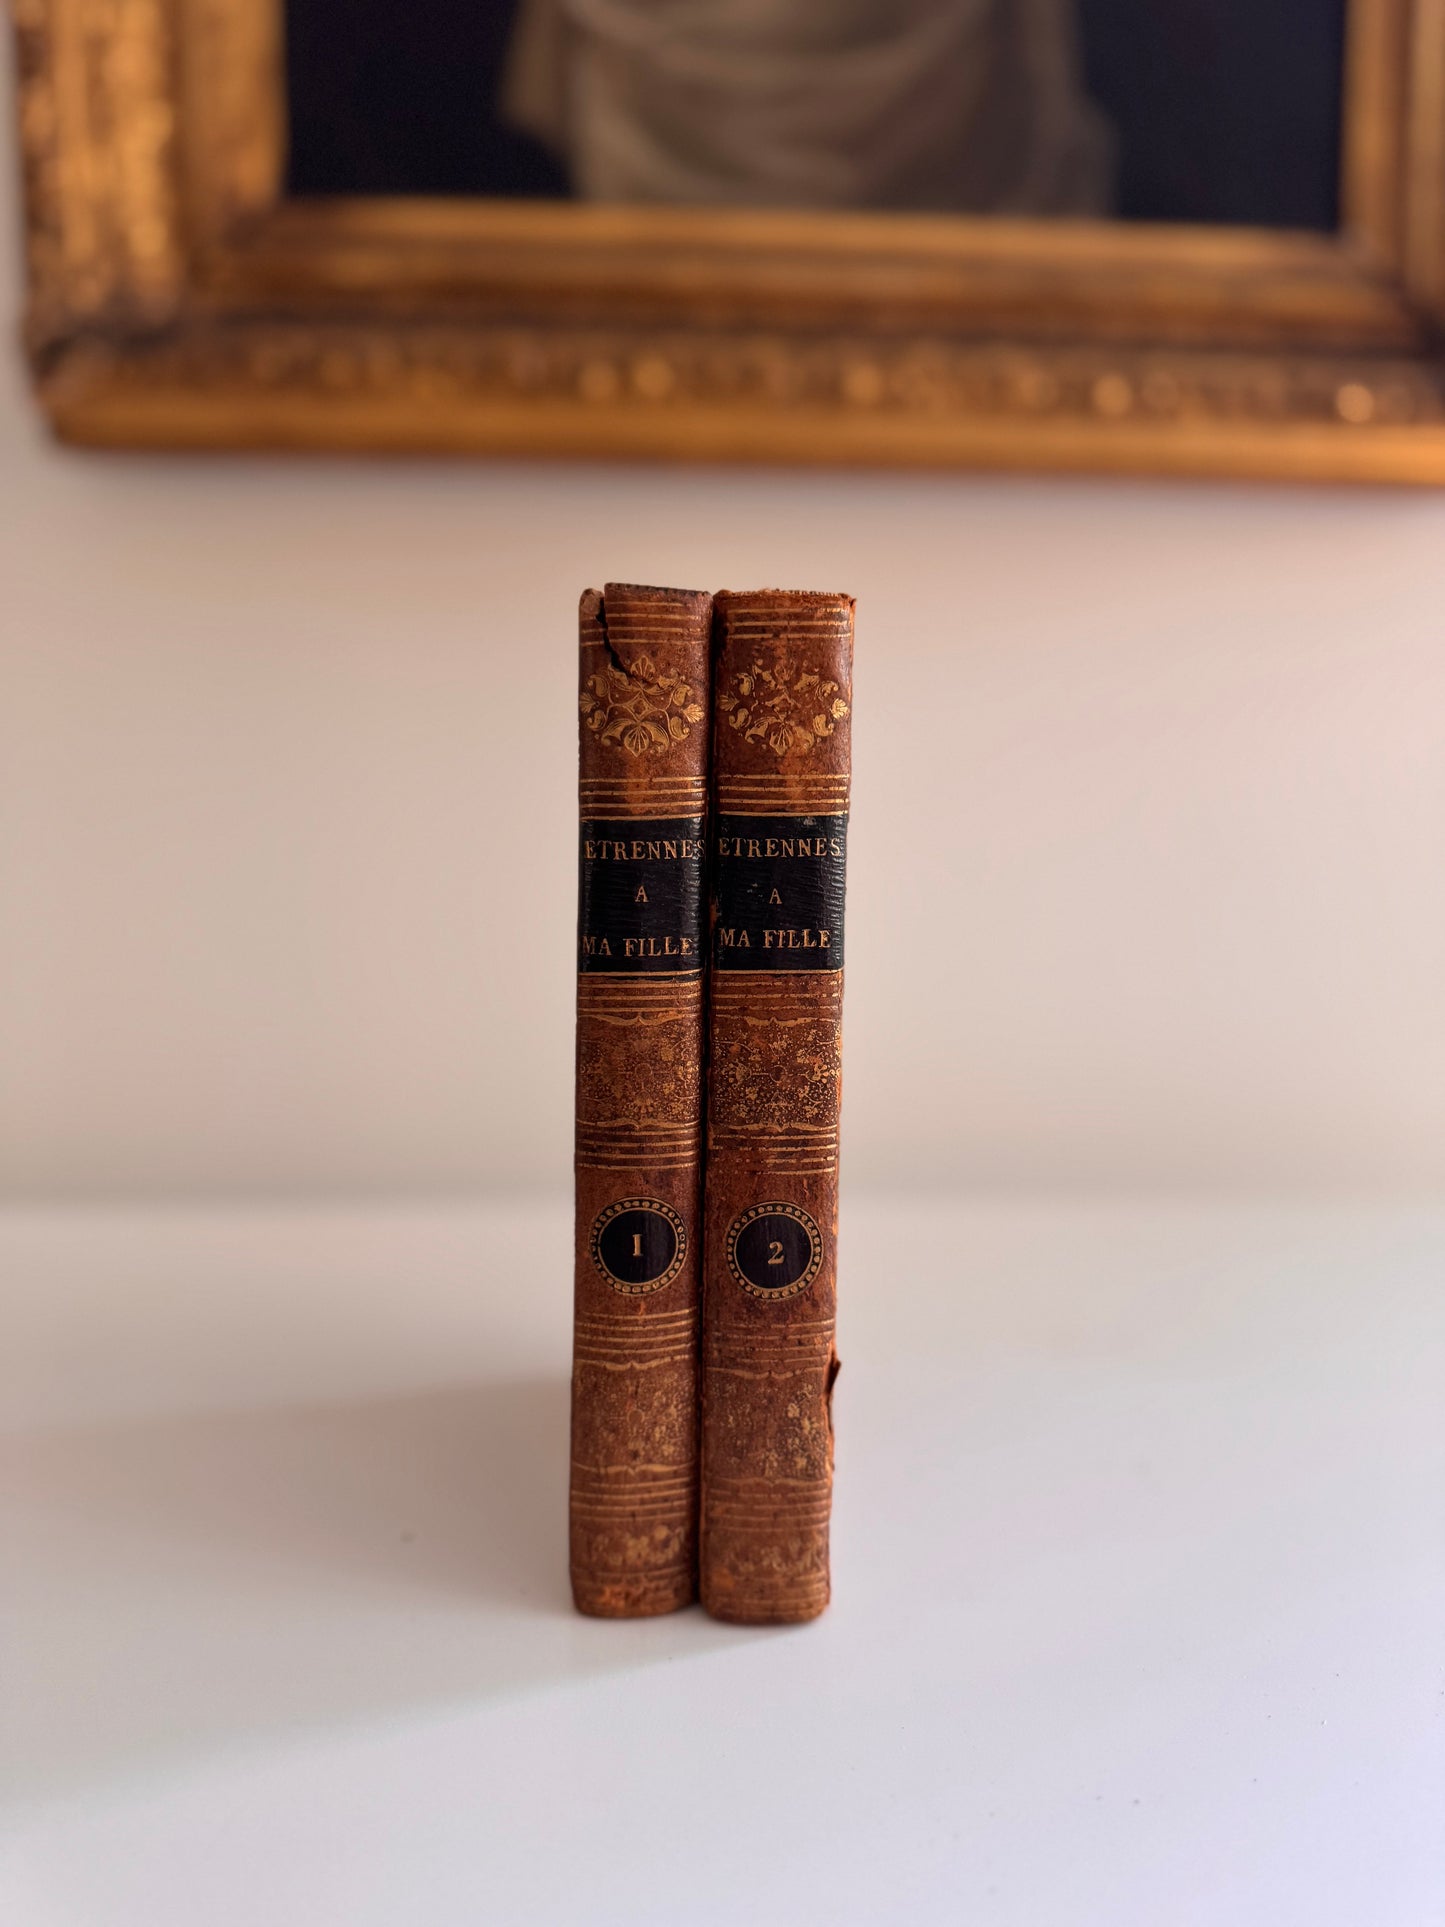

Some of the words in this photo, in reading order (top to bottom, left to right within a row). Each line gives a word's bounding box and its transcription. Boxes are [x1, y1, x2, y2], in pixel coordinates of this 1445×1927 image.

[584, 839, 705, 860] ETRENNES
[719, 837, 841, 858] ETRENNES
[635, 885, 649, 903] A
[769, 888, 783, 905] A
[582, 935, 612, 956] MA
[623, 936, 693, 957] FILLE
[719, 927, 751, 948] MA
[762, 928, 832, 949] FILLE
[768, 1241, 784, 1265] 2
